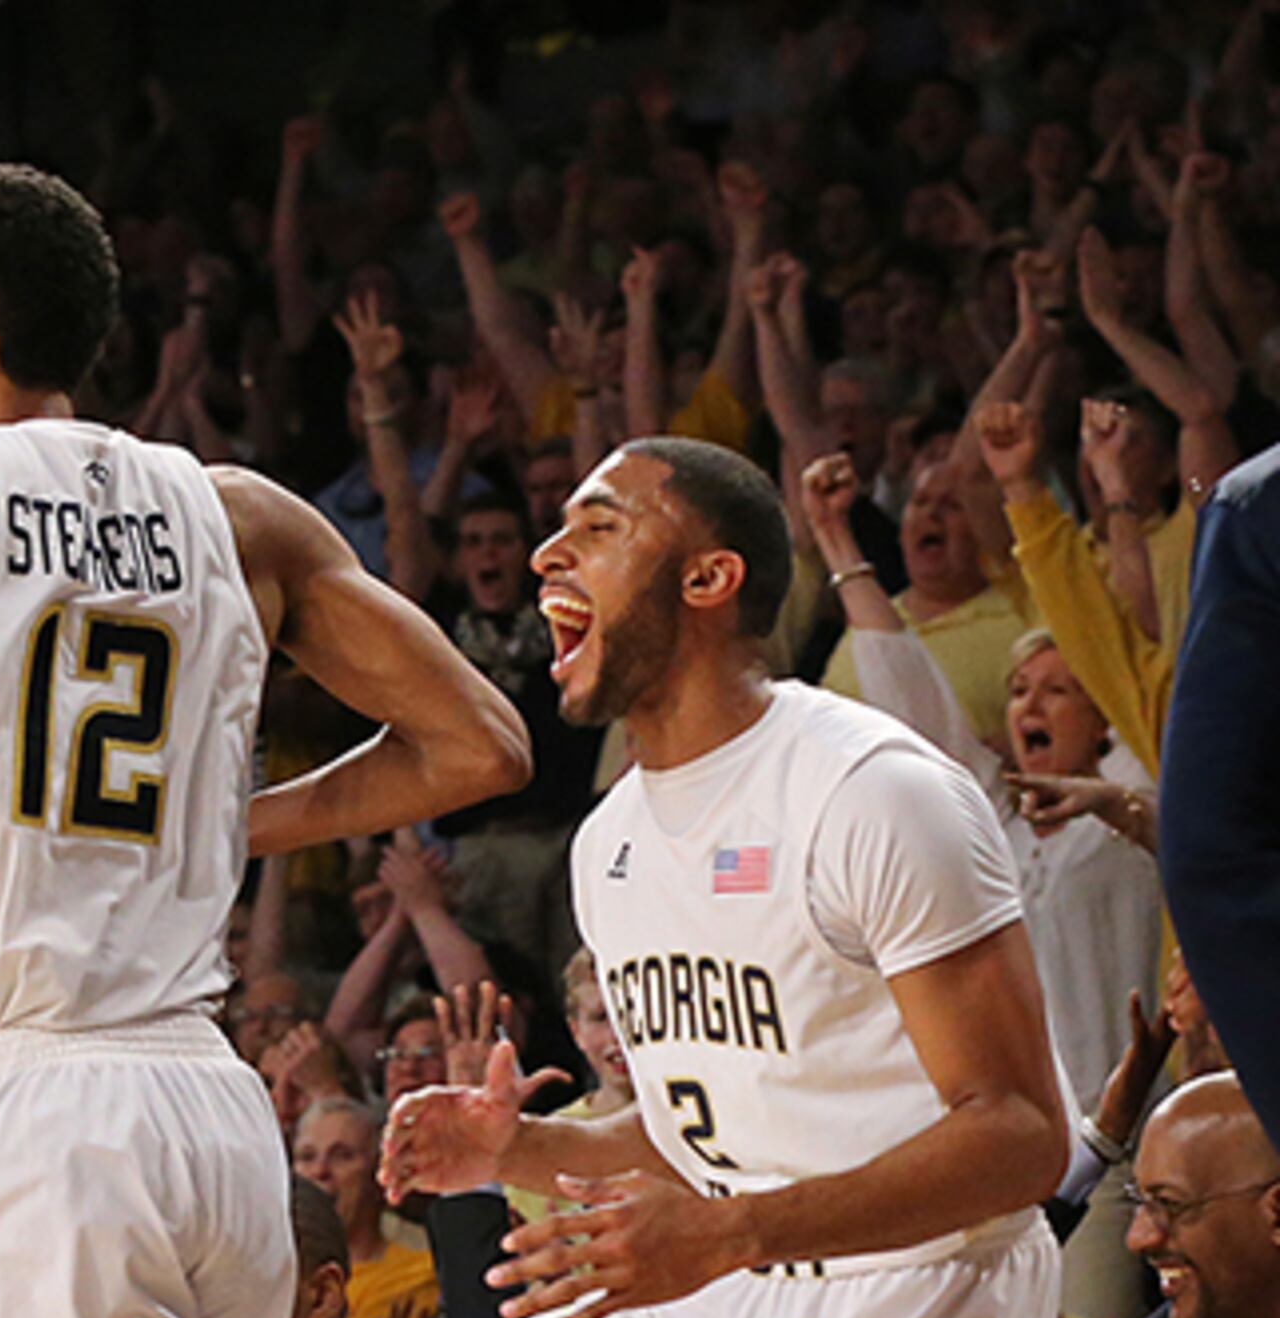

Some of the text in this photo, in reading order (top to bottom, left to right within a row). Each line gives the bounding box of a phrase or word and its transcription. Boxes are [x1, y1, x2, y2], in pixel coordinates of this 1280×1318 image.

[8, 493, 182, 593] STEENS
[11, 601, 180, 846] 12
[664, 1075, 742, 1171] 2
